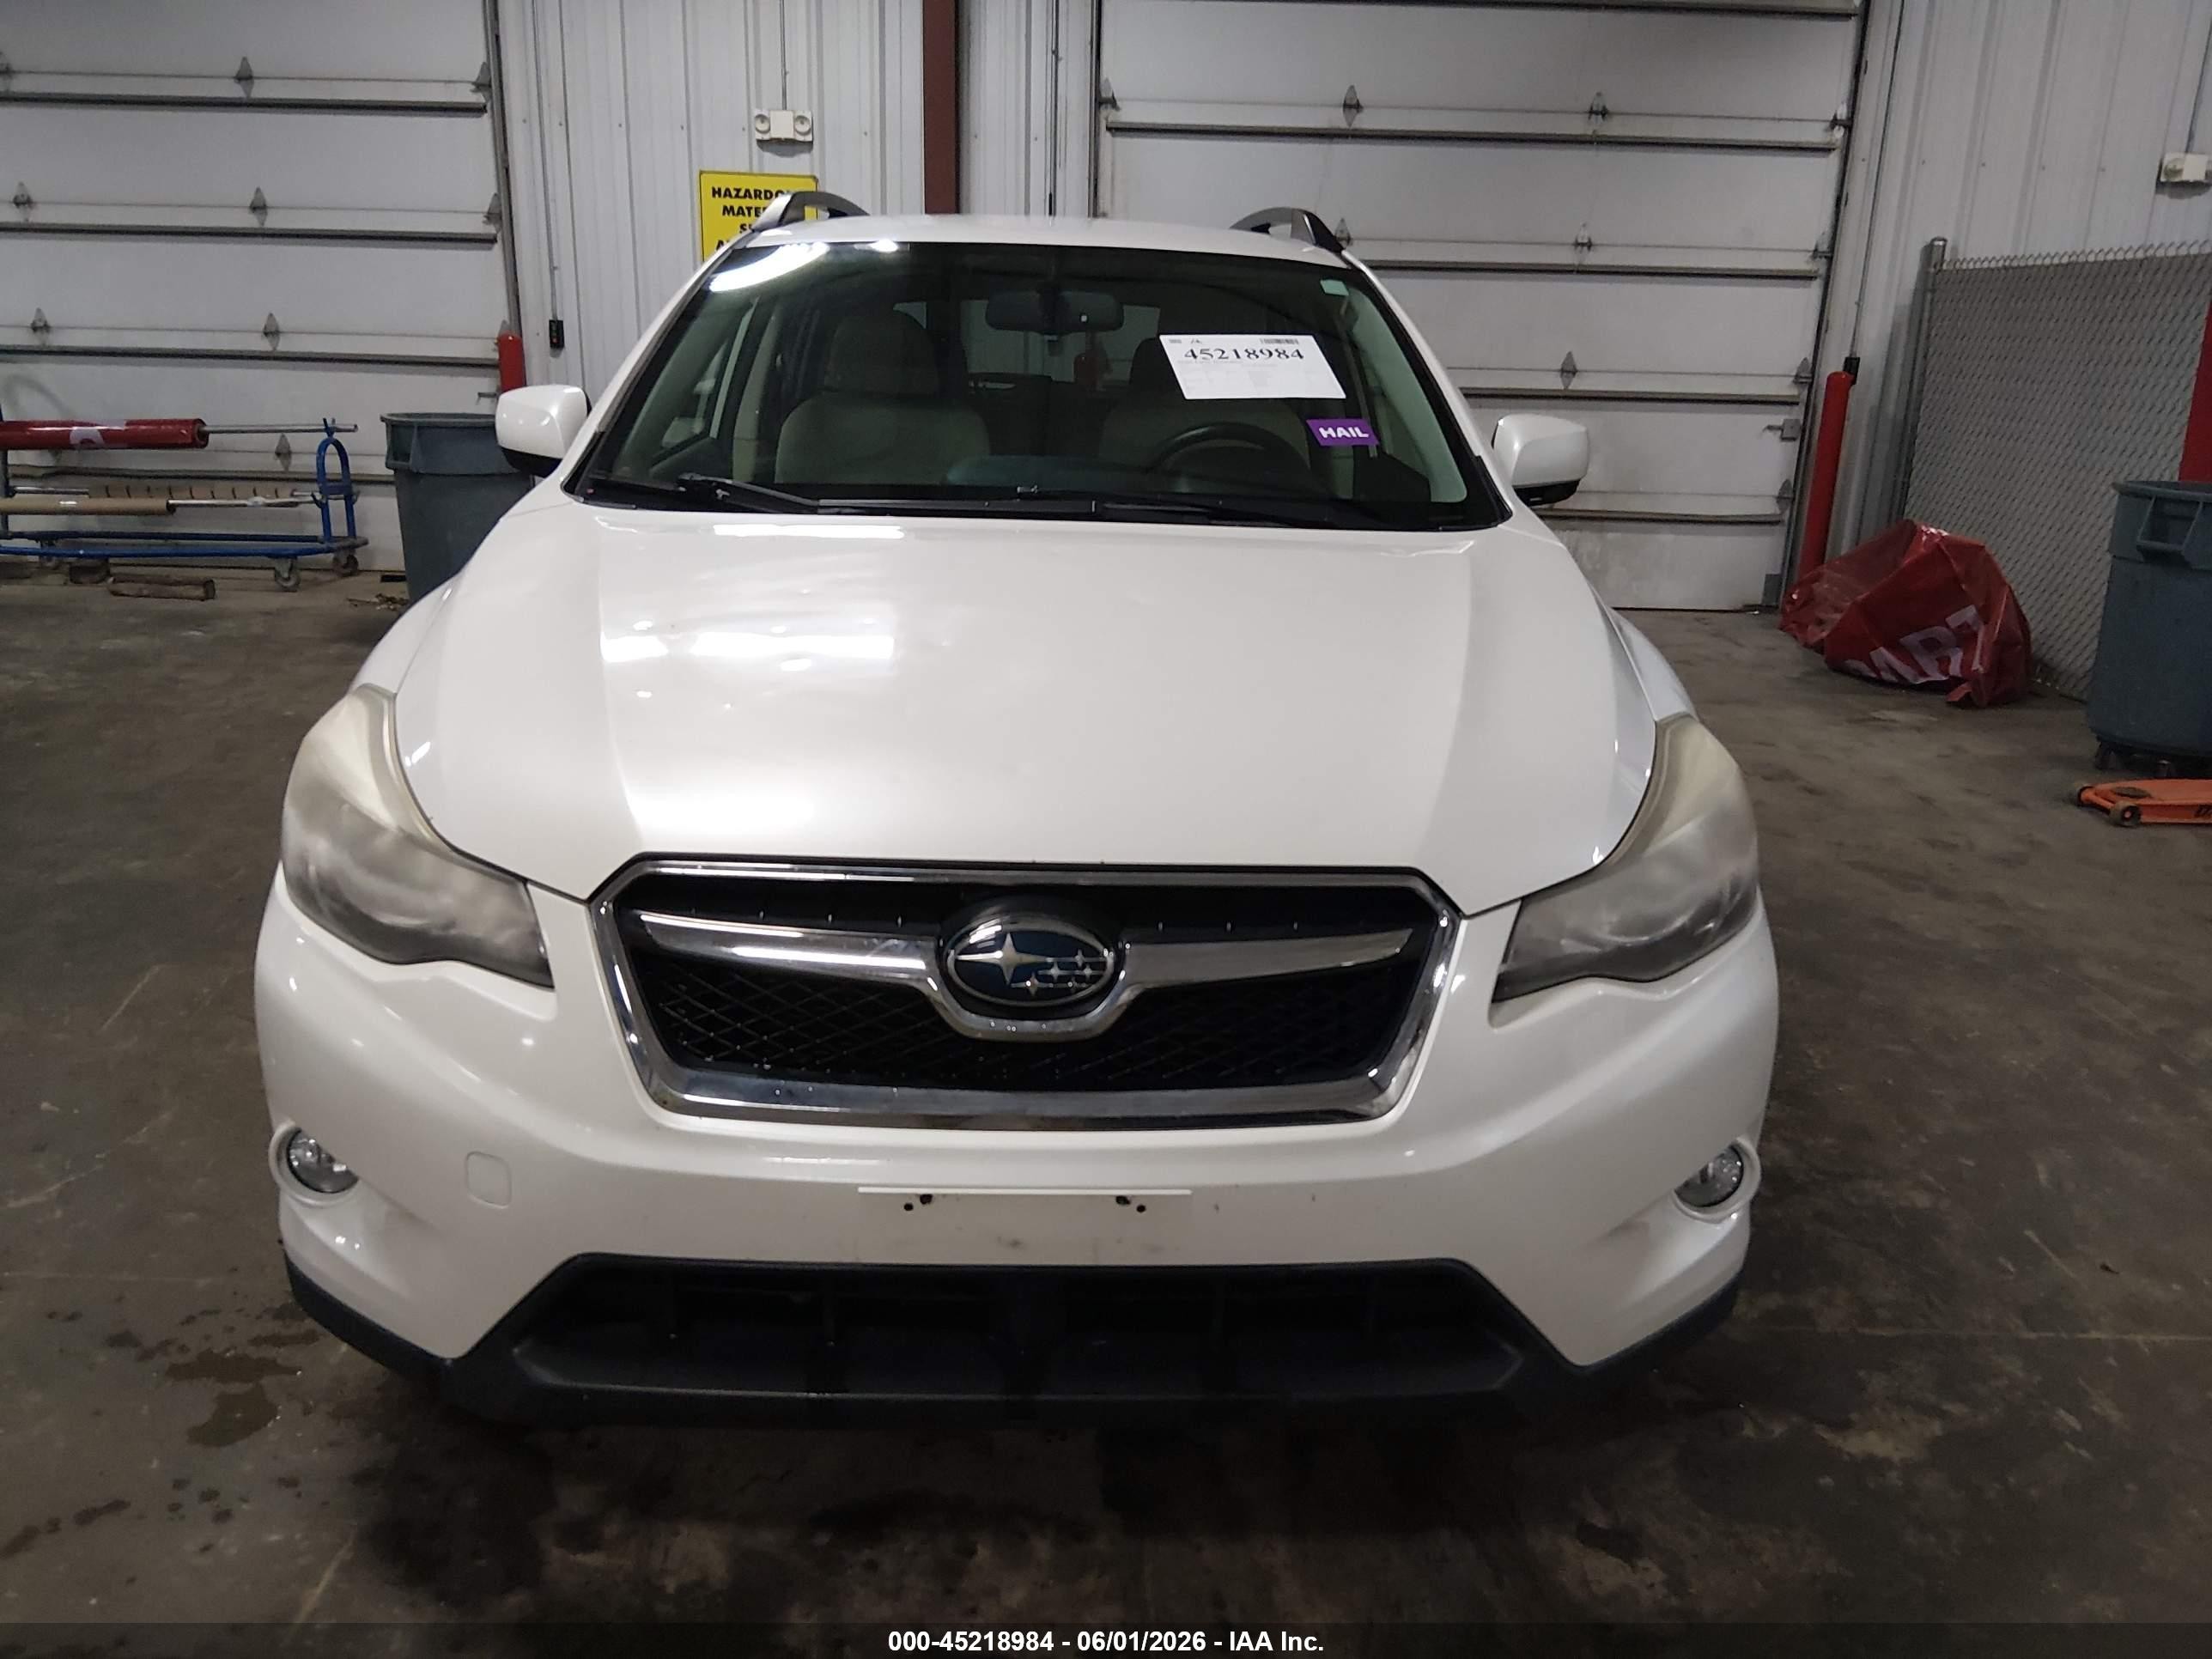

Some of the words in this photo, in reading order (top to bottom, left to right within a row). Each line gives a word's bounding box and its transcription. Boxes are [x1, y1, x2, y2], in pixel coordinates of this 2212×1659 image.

[711, 186, 790, 200] HAZARDO
[1184, 348, 1304, 360] 45218984
[1319, 427, 1369, 439] HAIL
